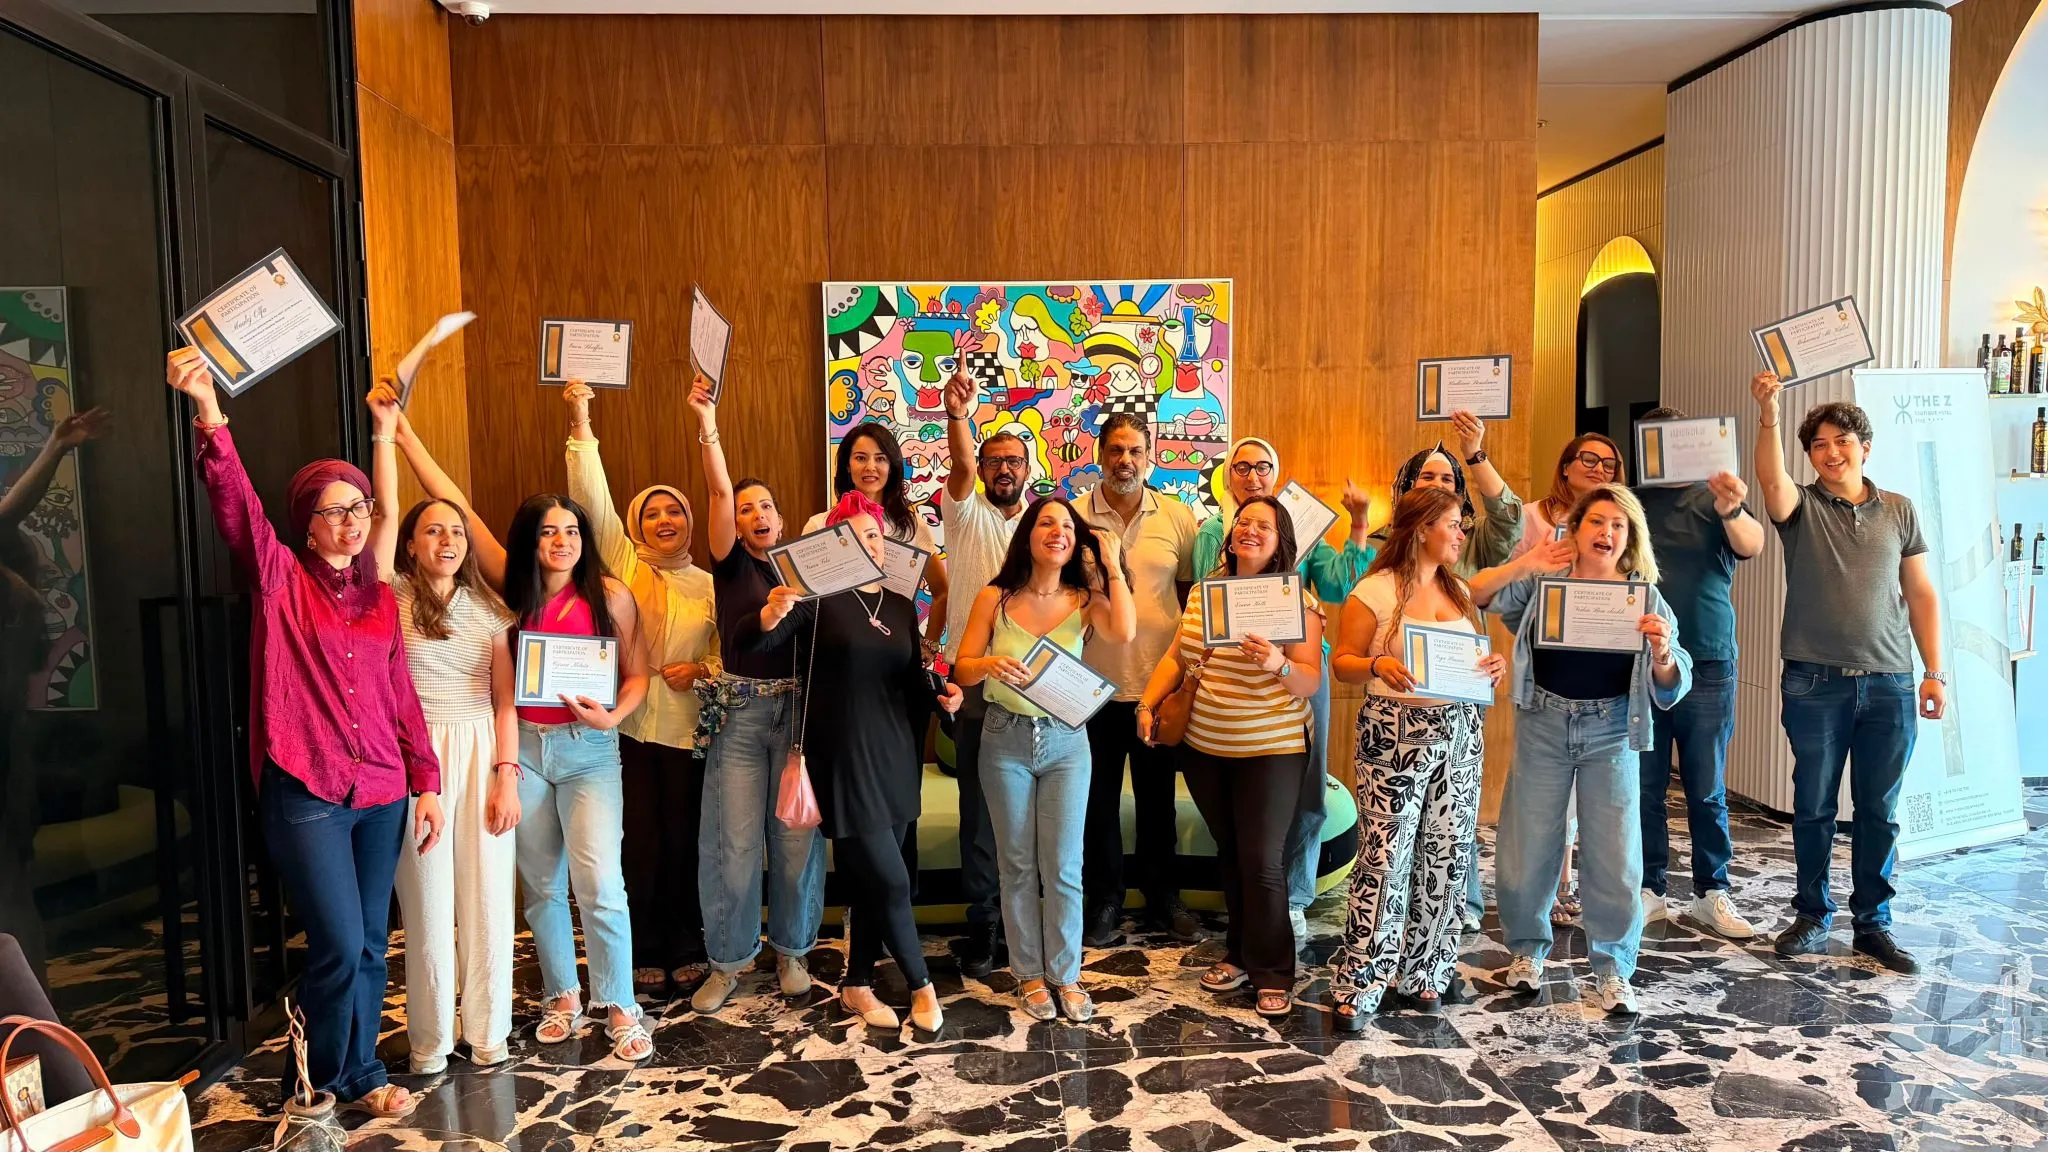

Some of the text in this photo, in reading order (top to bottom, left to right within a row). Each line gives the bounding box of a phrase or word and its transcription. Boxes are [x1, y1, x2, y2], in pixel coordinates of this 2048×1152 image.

[217, 290, 250, 313] CERTIFICATE
[221, 292, 260, 318] PARTICIPATION
[1788, 319, 1817, 331] CERTIFICATE
[1790, 321, 1825, 335] PARTICIPATION
[1913, 395, 1952, 407] THE Z
